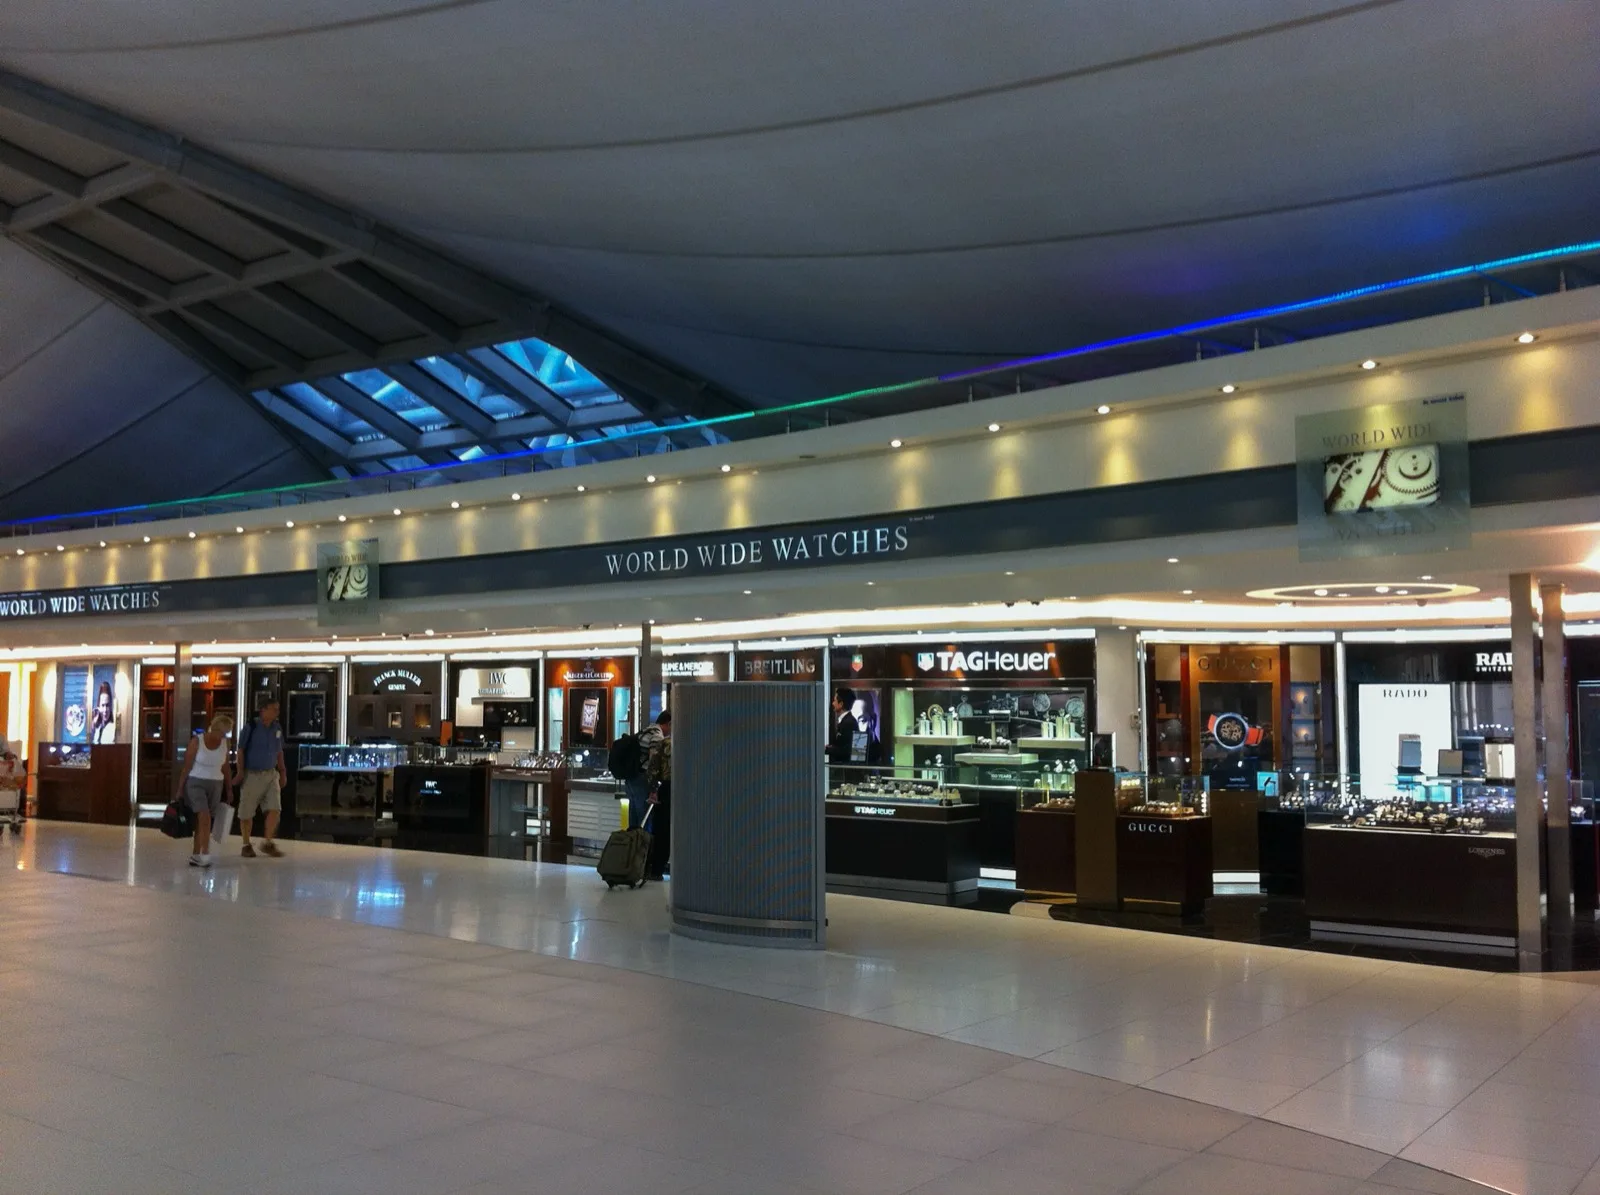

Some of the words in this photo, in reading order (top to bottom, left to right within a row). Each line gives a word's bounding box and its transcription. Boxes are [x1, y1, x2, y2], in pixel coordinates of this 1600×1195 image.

[1322, 429, 1385, 449] WORLD
[606, 548, 689, 575] WORLD
[698, 541, 763, 567] WIDE
[772, 526, 909, 561] WATCHES
[0, 598, 47, 616] WORLD
[50, 595, 86, 614] WIDE
[90, 591, 160, 611] WATCHES
[745, 658, 816, 675] BREITLING
[1197, 655, 1274, 671] GUCCI
[1383, 689, 1428, 698] RADO
[1128, 822, 1173, 833] GUCCI
